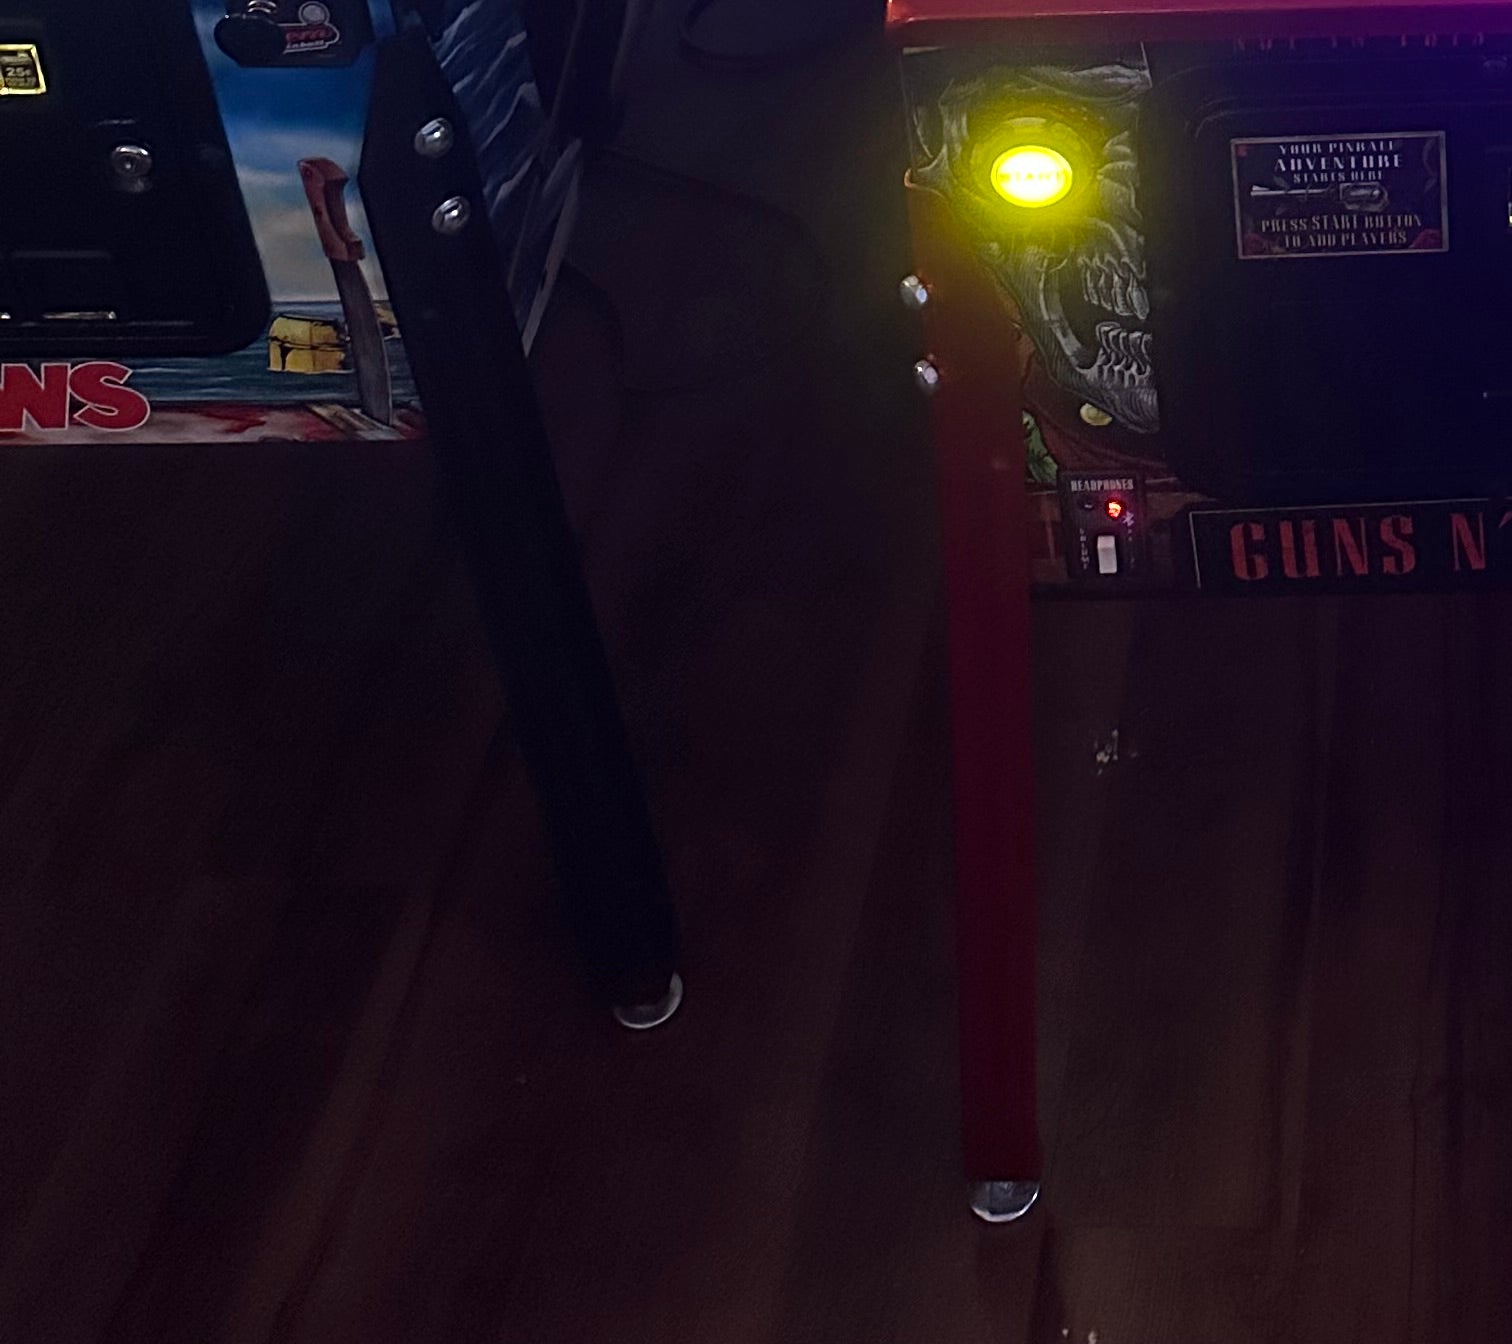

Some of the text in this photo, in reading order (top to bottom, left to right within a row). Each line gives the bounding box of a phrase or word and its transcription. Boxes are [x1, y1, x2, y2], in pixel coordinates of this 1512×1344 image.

[1279, 140, 1394, 155] YOUR PINBALL
[1275, 154, 1402, 172] ADVENTURE
[1293, 170, 1383, 184] STARTS HERE
[1261, 213, 1422, 233] PRESS START BUTTON
[1284, 231, 1407, 249] TO ADD PLAYERS
[1070, 478, 1134, 492] HEADPHONES
[1229, 514, 1418, 581] GUNS
